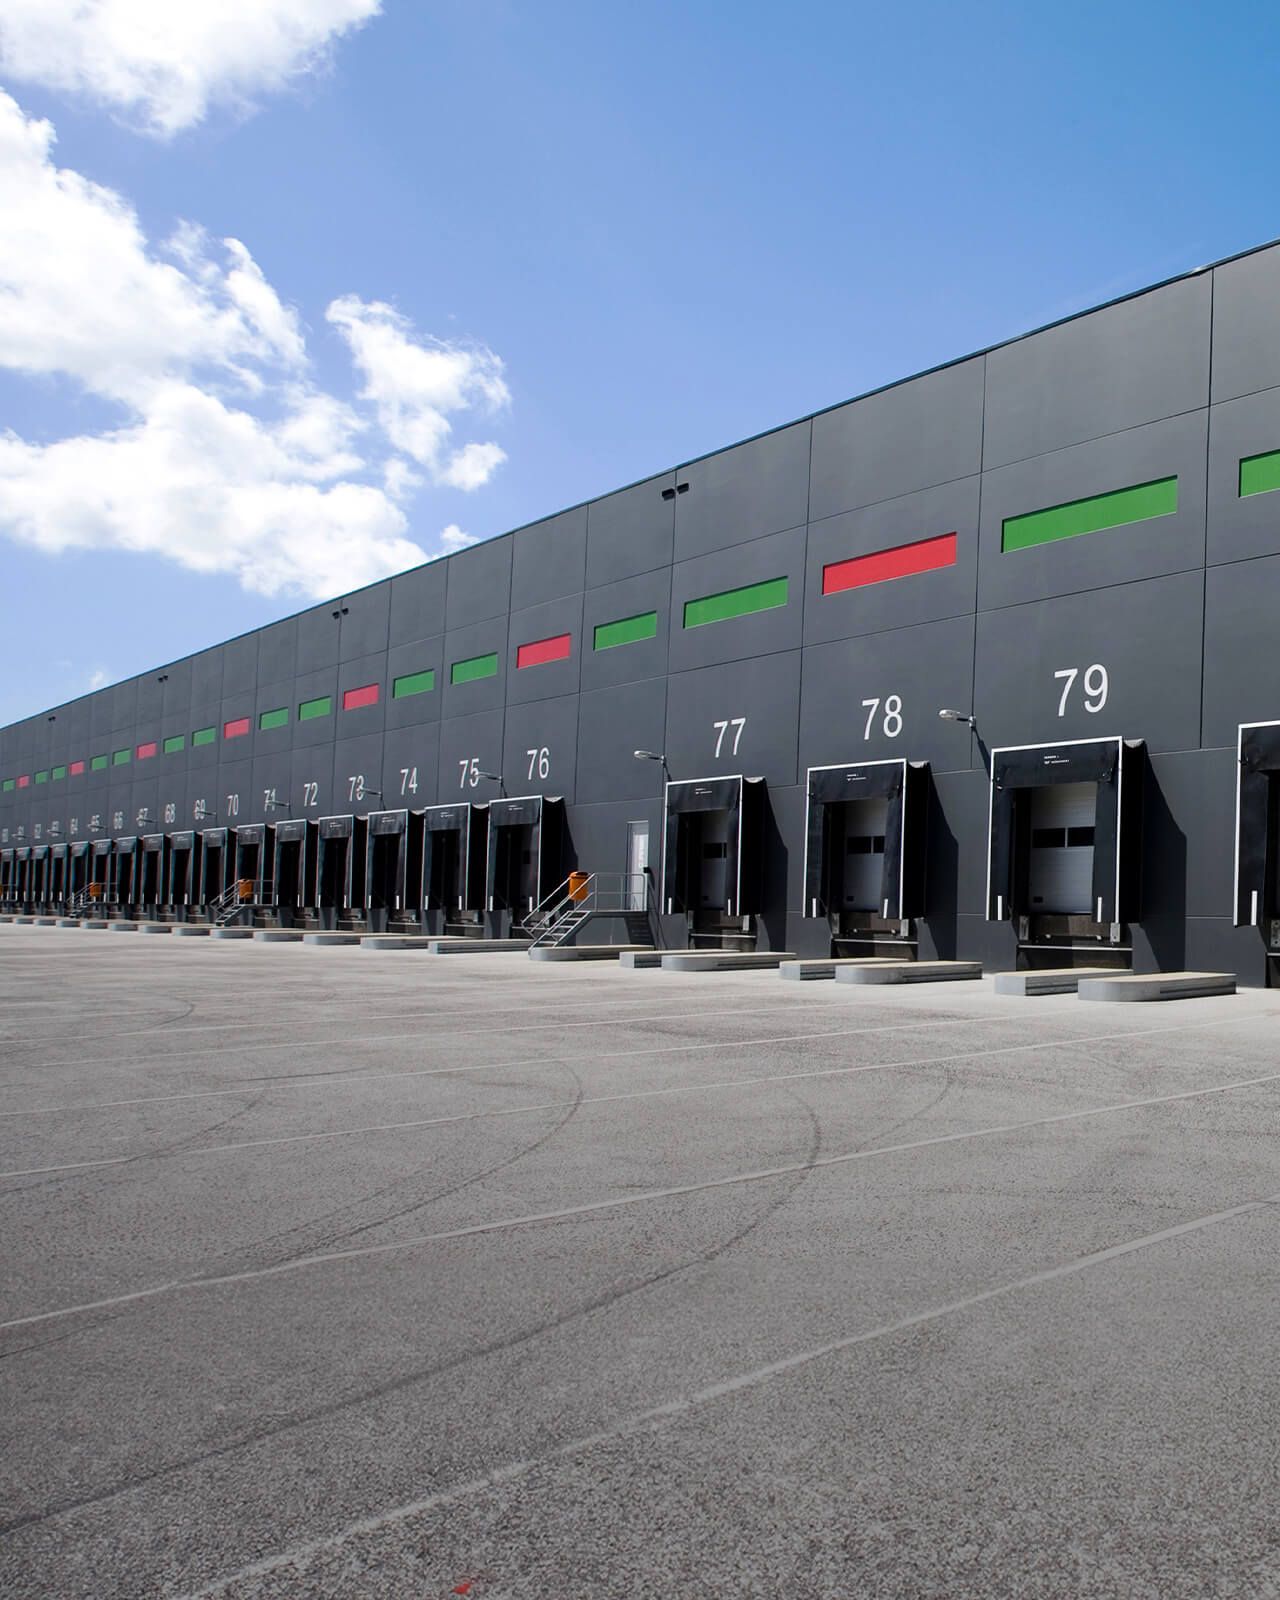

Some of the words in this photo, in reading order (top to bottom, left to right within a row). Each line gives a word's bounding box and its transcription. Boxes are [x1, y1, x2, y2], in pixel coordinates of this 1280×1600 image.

[1054, 663, 1109, 717] 79
[862, 695, 903, 741] 78
[713, 717, 747, 758] 77
[459, 758, 480, 788] 75
[526, 747, 550, 781] 76
[303, 782, 318, 806] 72
[349, 775, 365, 801] 73
[400, 767, 418, 795] 74
[165, 803, 175, 823] 68
[227, 794, 239, 816] 70
[264, 788, 276, 812] 71
